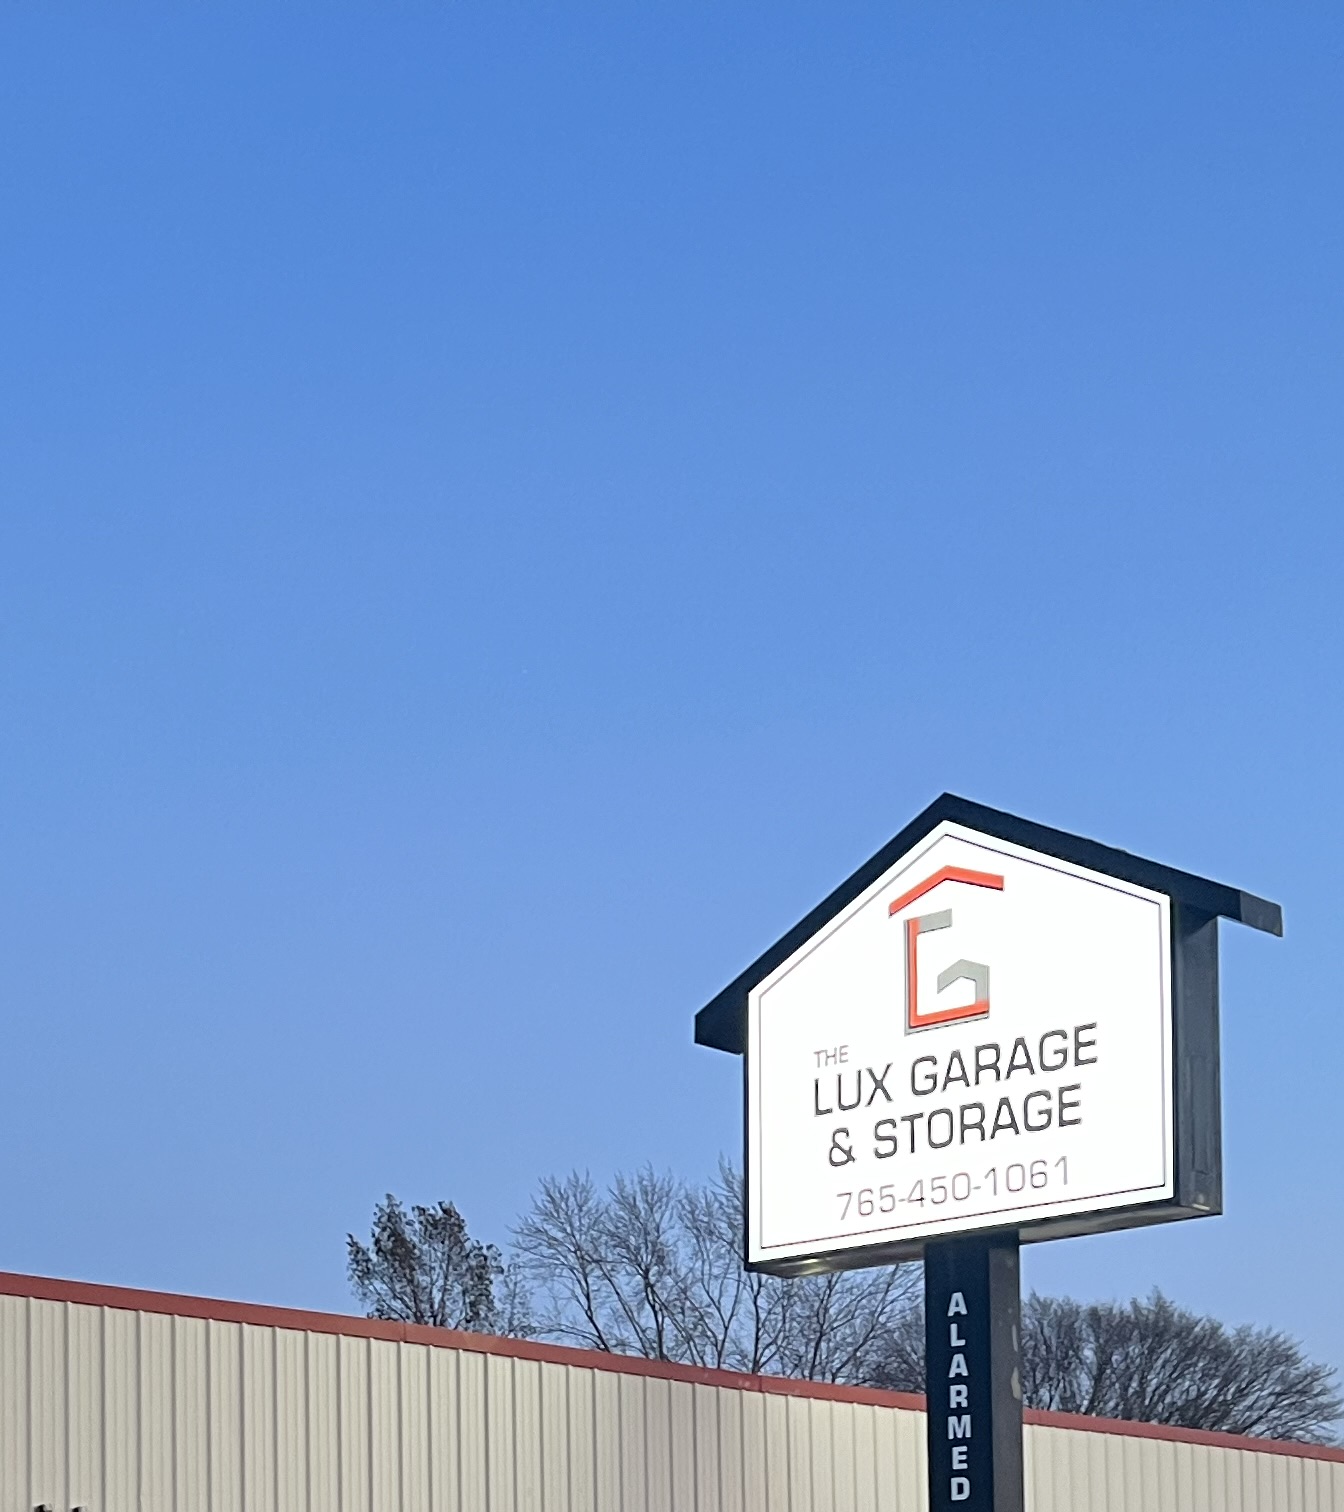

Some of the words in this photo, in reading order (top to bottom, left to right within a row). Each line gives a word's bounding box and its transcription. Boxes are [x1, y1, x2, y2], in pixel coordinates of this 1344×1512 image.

[813, 1045, 849, 1068] THE
[814, 1062, 893, 1117] LUX
[910, 1021, 1098, 1097] GARAGE
[828, 1127, 856, 1167] &
[873, 1083, 1082, 1159] STORAGE
[836, 1155, 1069, 1221] 765-450-1061
[947, 1291, 972, 1502] ALARMED
